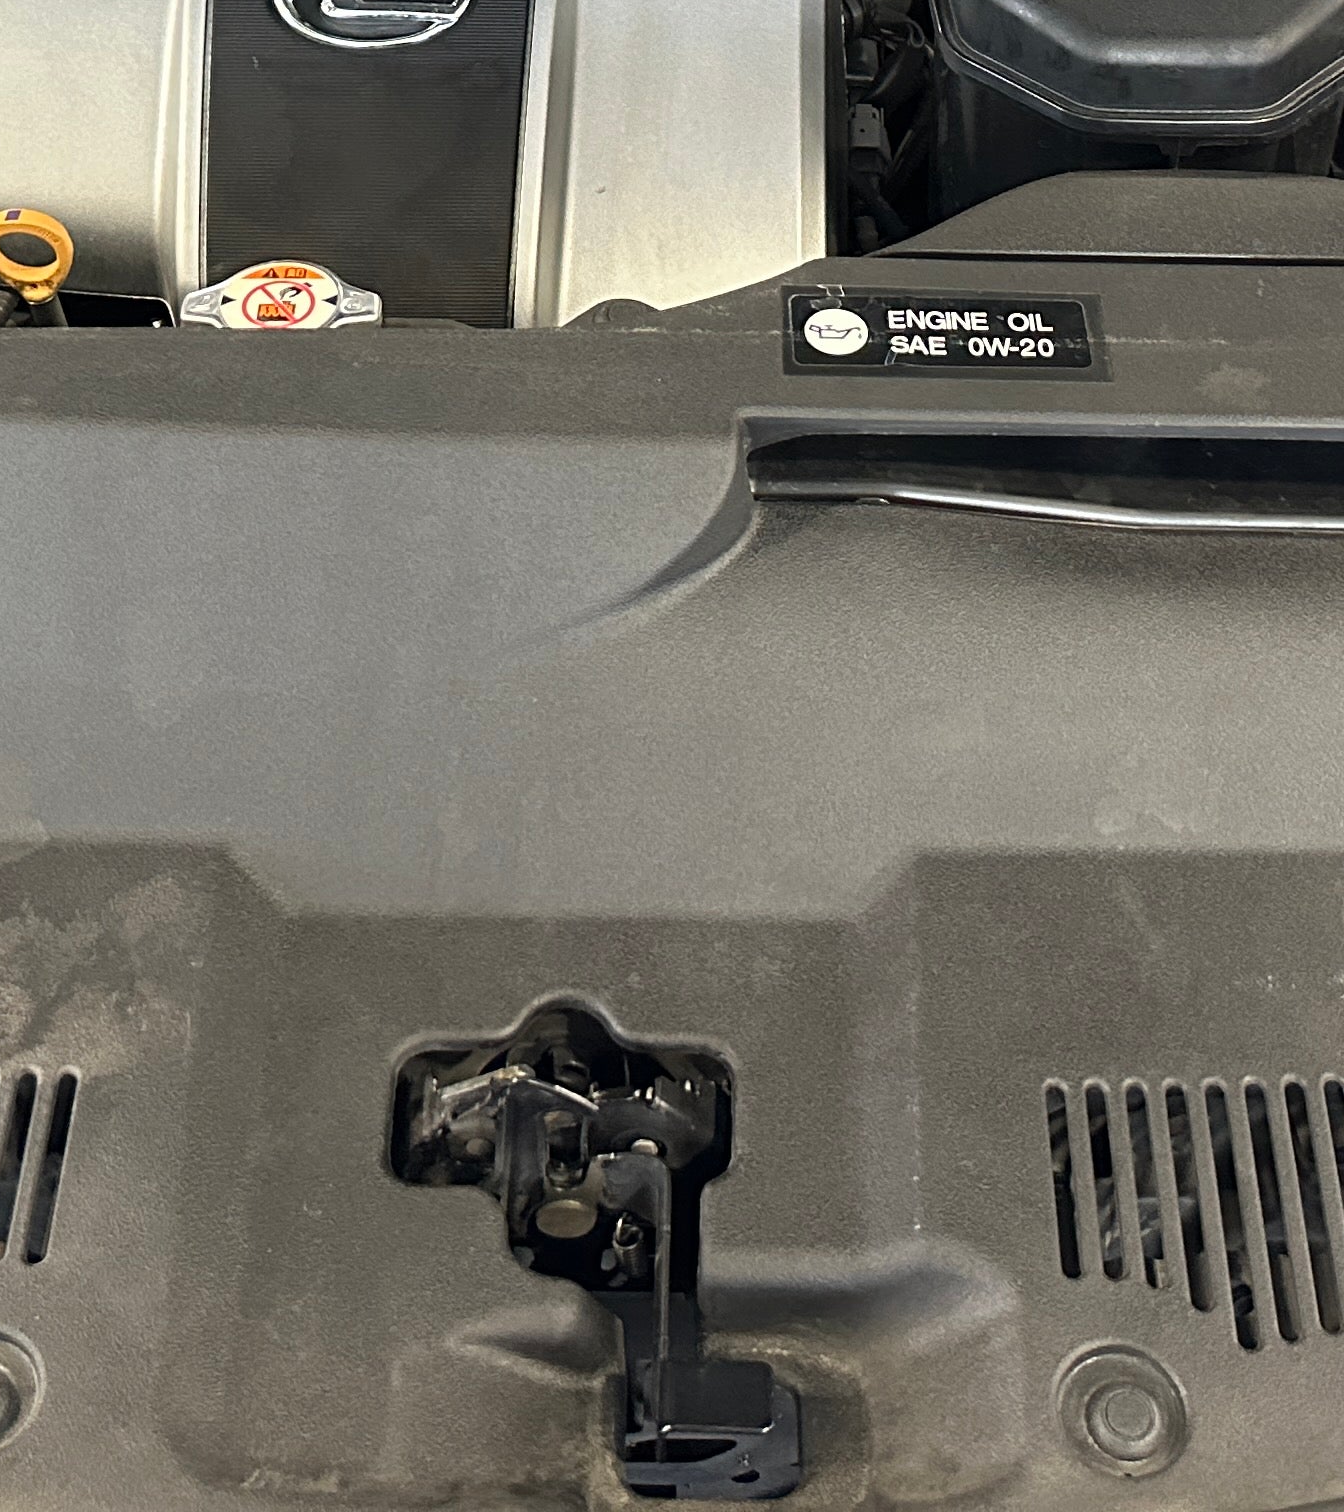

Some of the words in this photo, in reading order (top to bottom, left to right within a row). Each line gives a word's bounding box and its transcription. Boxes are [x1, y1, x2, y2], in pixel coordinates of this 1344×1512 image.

[887, 308, 990, 331] ENGINE
[1007, 312, 1054, 332] OIL
[890, 334, 948, 356] SAE
[967, 336, 1055, 358] 0W-20
